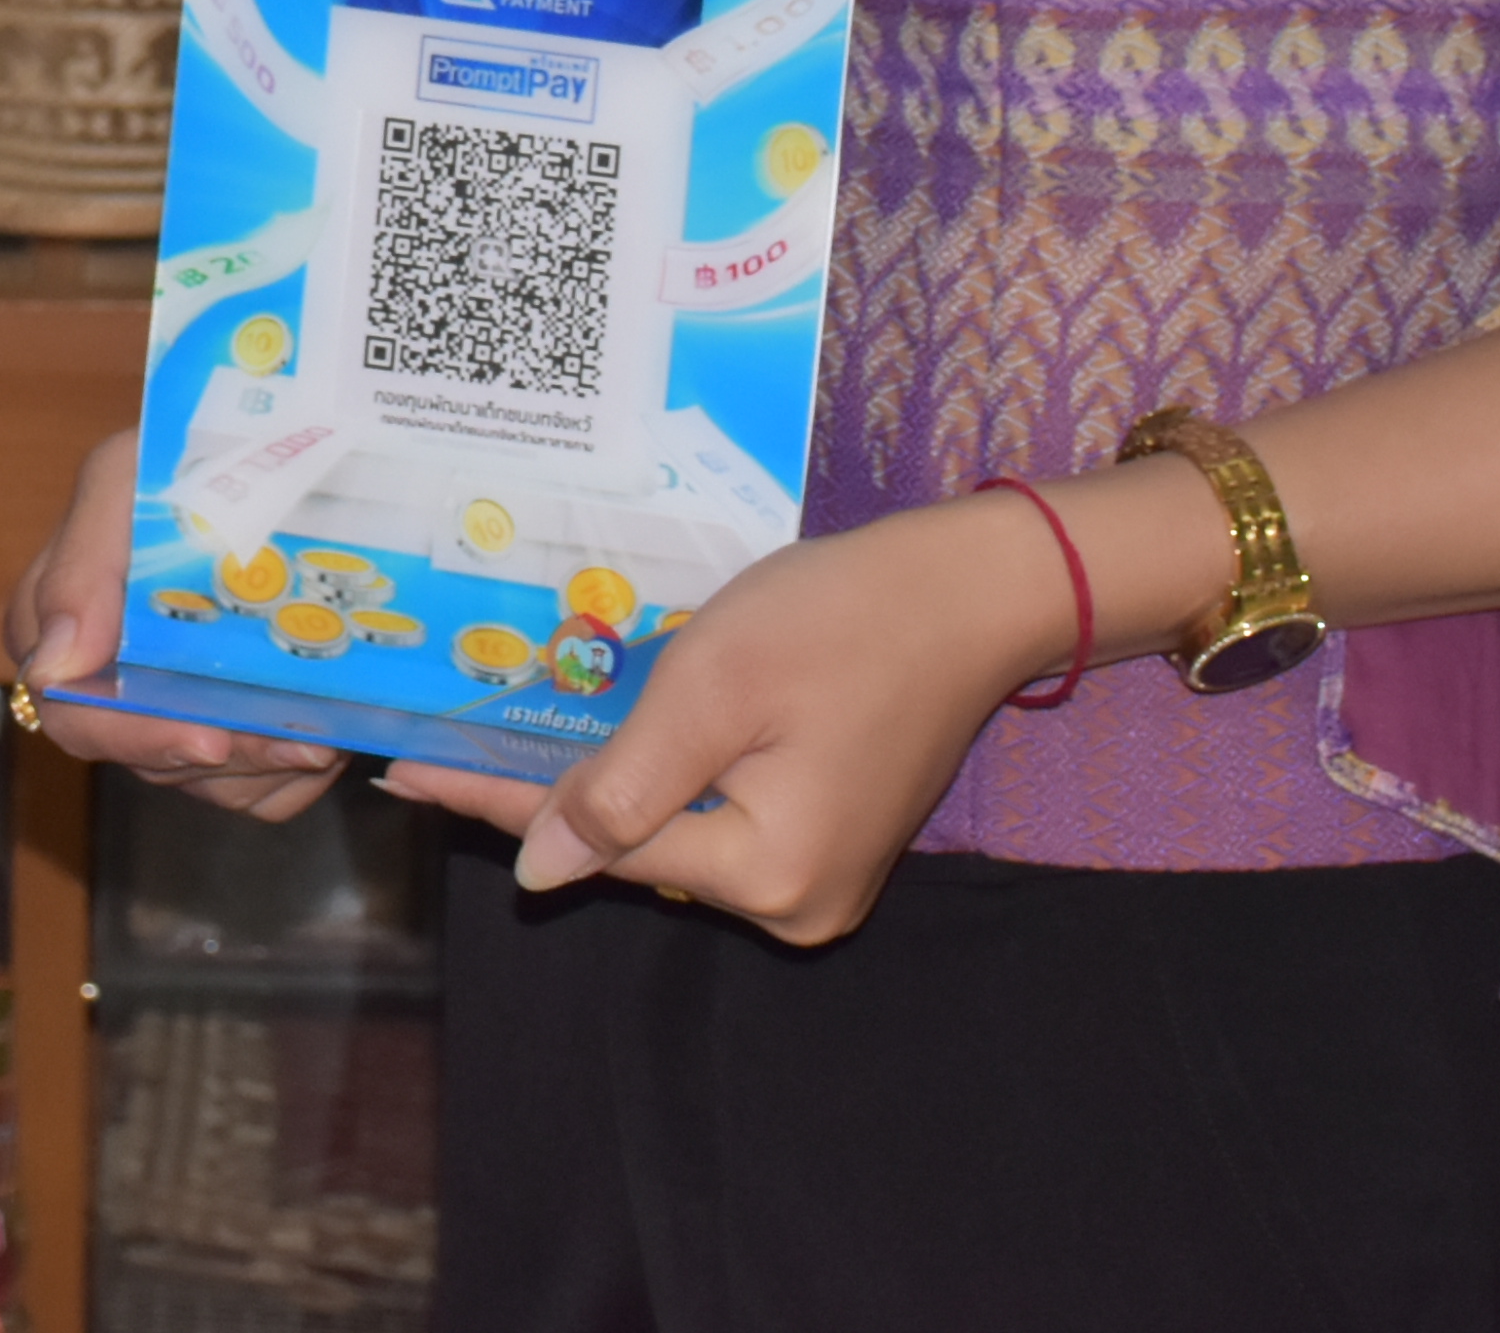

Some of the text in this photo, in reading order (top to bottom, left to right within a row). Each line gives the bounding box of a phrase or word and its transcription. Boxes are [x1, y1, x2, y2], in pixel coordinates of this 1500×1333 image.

[725, 239, 789, 281] 100
[503, 703, 620, 737] เราเที่ยวด้วย
